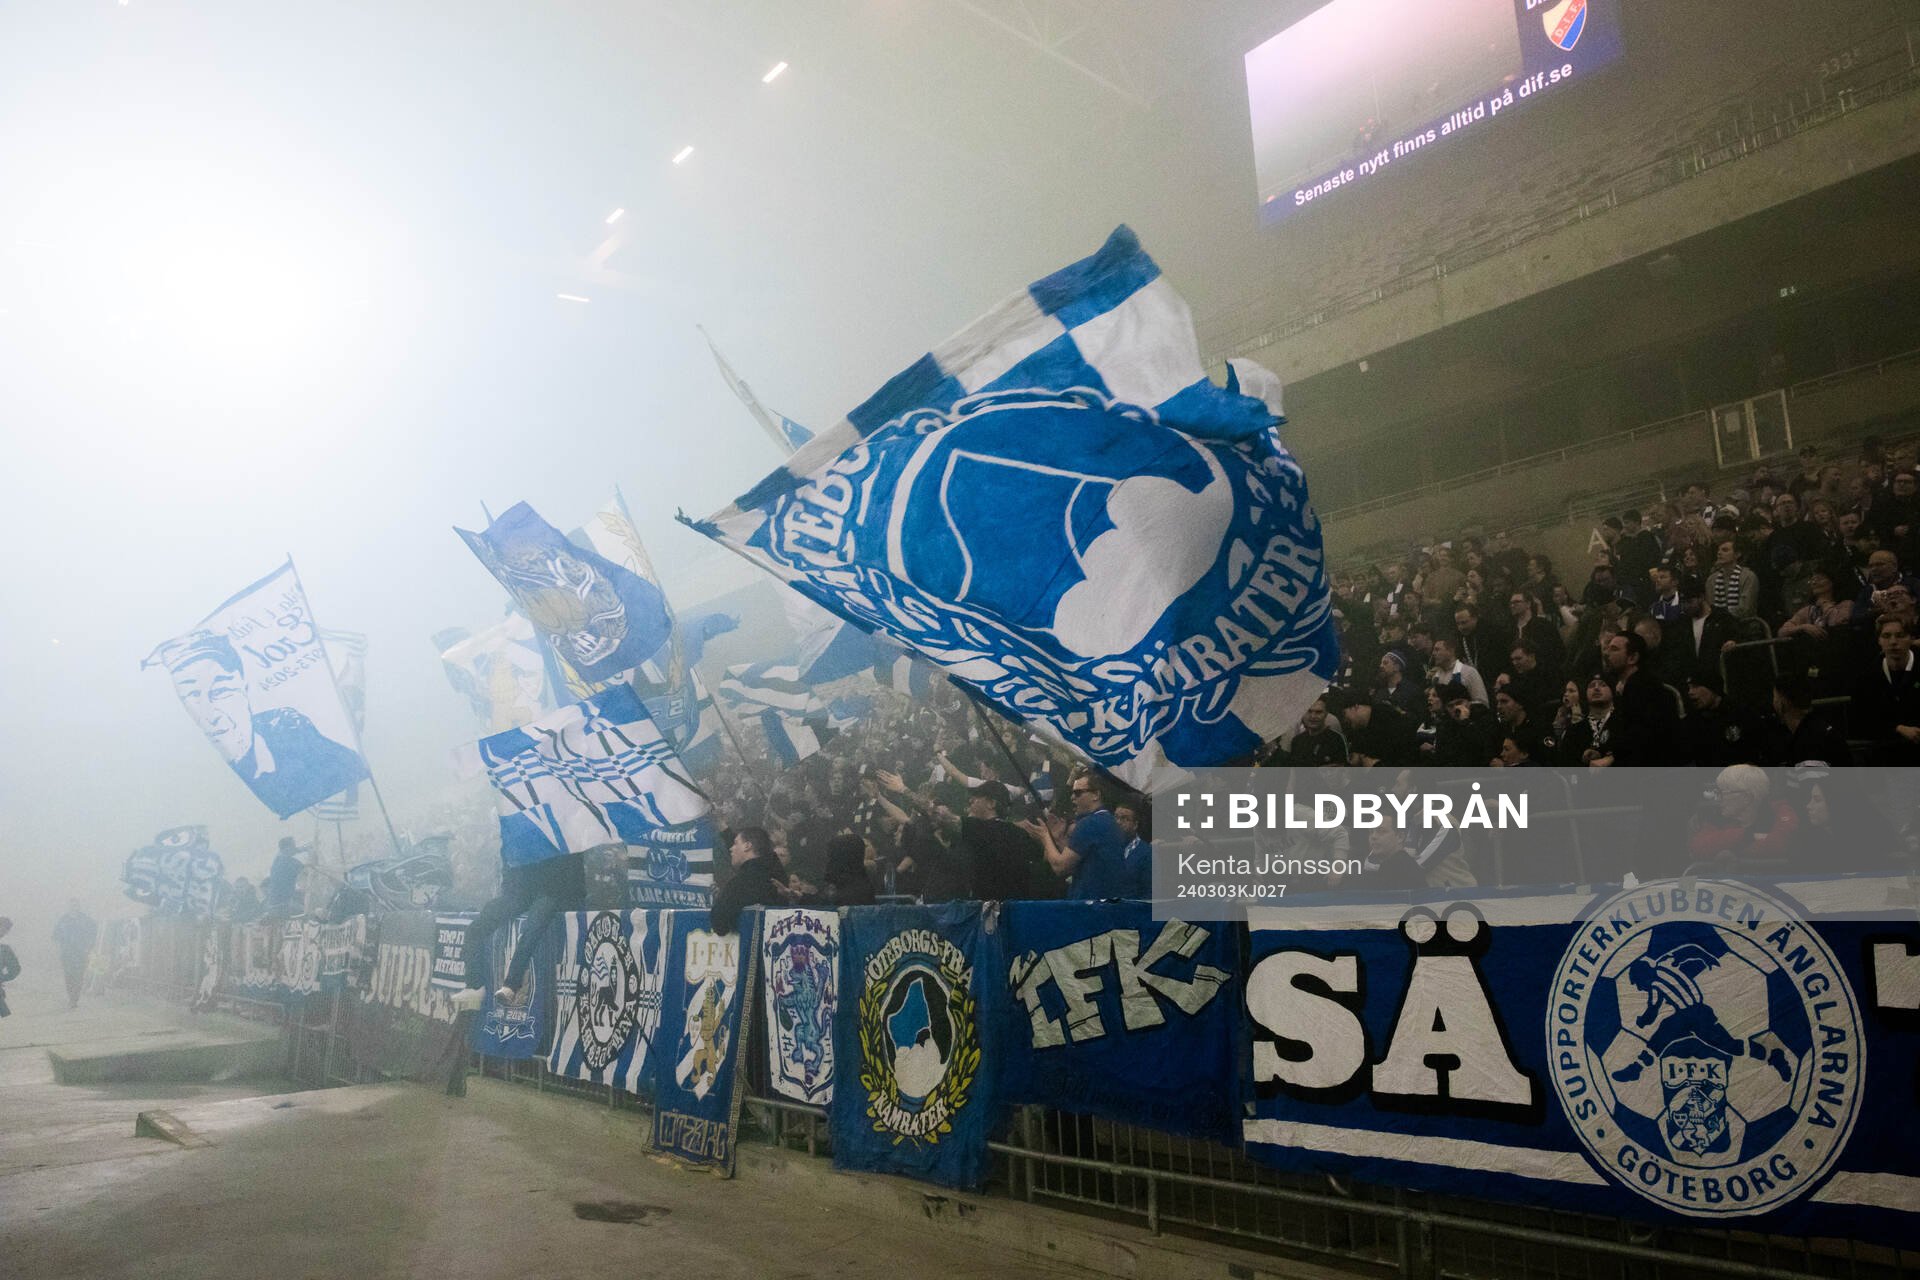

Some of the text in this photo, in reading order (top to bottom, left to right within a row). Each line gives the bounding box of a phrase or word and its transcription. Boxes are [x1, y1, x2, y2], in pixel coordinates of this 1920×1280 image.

[1294, 62, 1573, 206] Senaste nytt finns alltid på dif.se
[1245, 909, 1531, 1105] SÄ
[1556, 888, 1849, 1130] SUPPORTERKLUBBEN ÄNGLARNA
[873, 1089, 951, 1135] KAMRATER
[1617, 1144, 1798, 1204] GÖTEBORG
